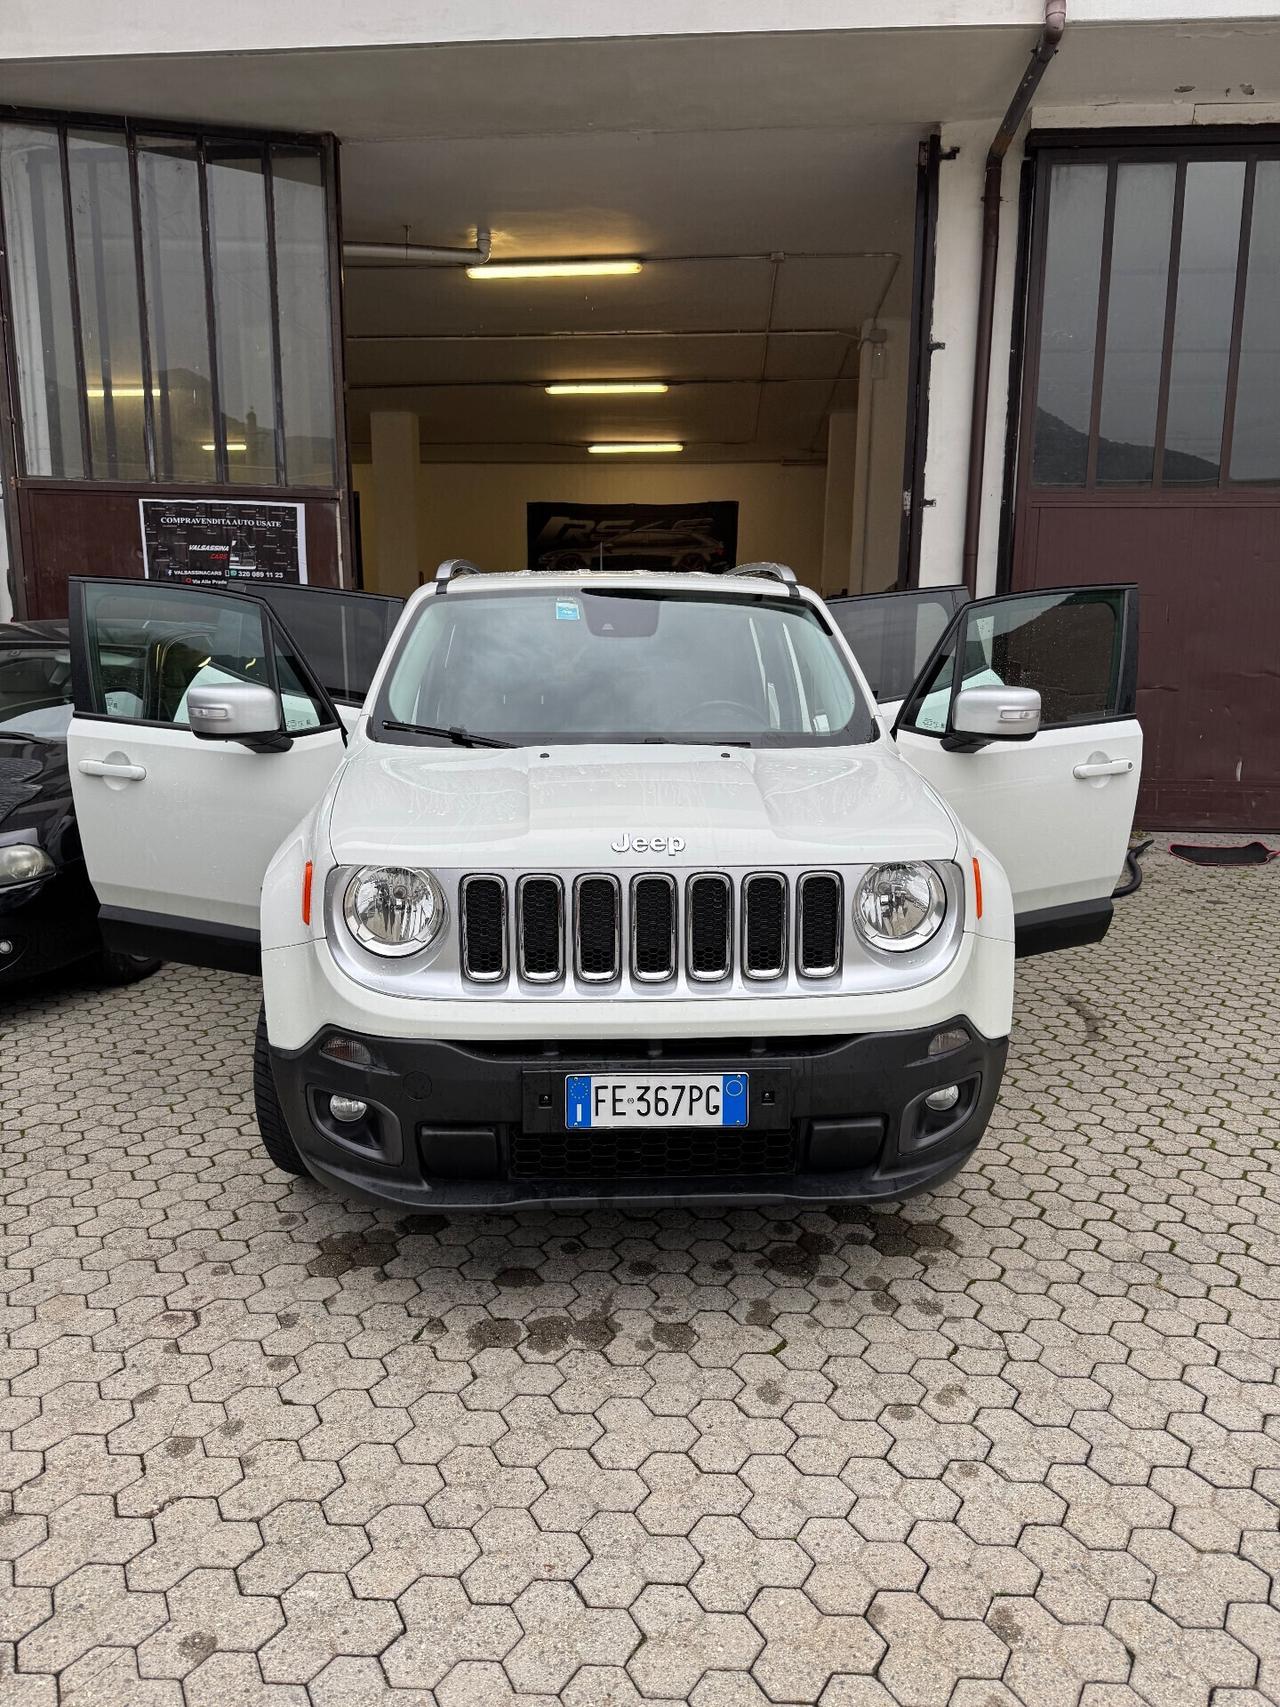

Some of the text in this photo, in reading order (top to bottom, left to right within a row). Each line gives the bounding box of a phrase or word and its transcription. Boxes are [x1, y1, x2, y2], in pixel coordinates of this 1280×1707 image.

[160, 516, 231, 526] COMPRAVENDITA
[256, 520, 282, 528] USATE
[611, 833, 686, 857] Jeep
